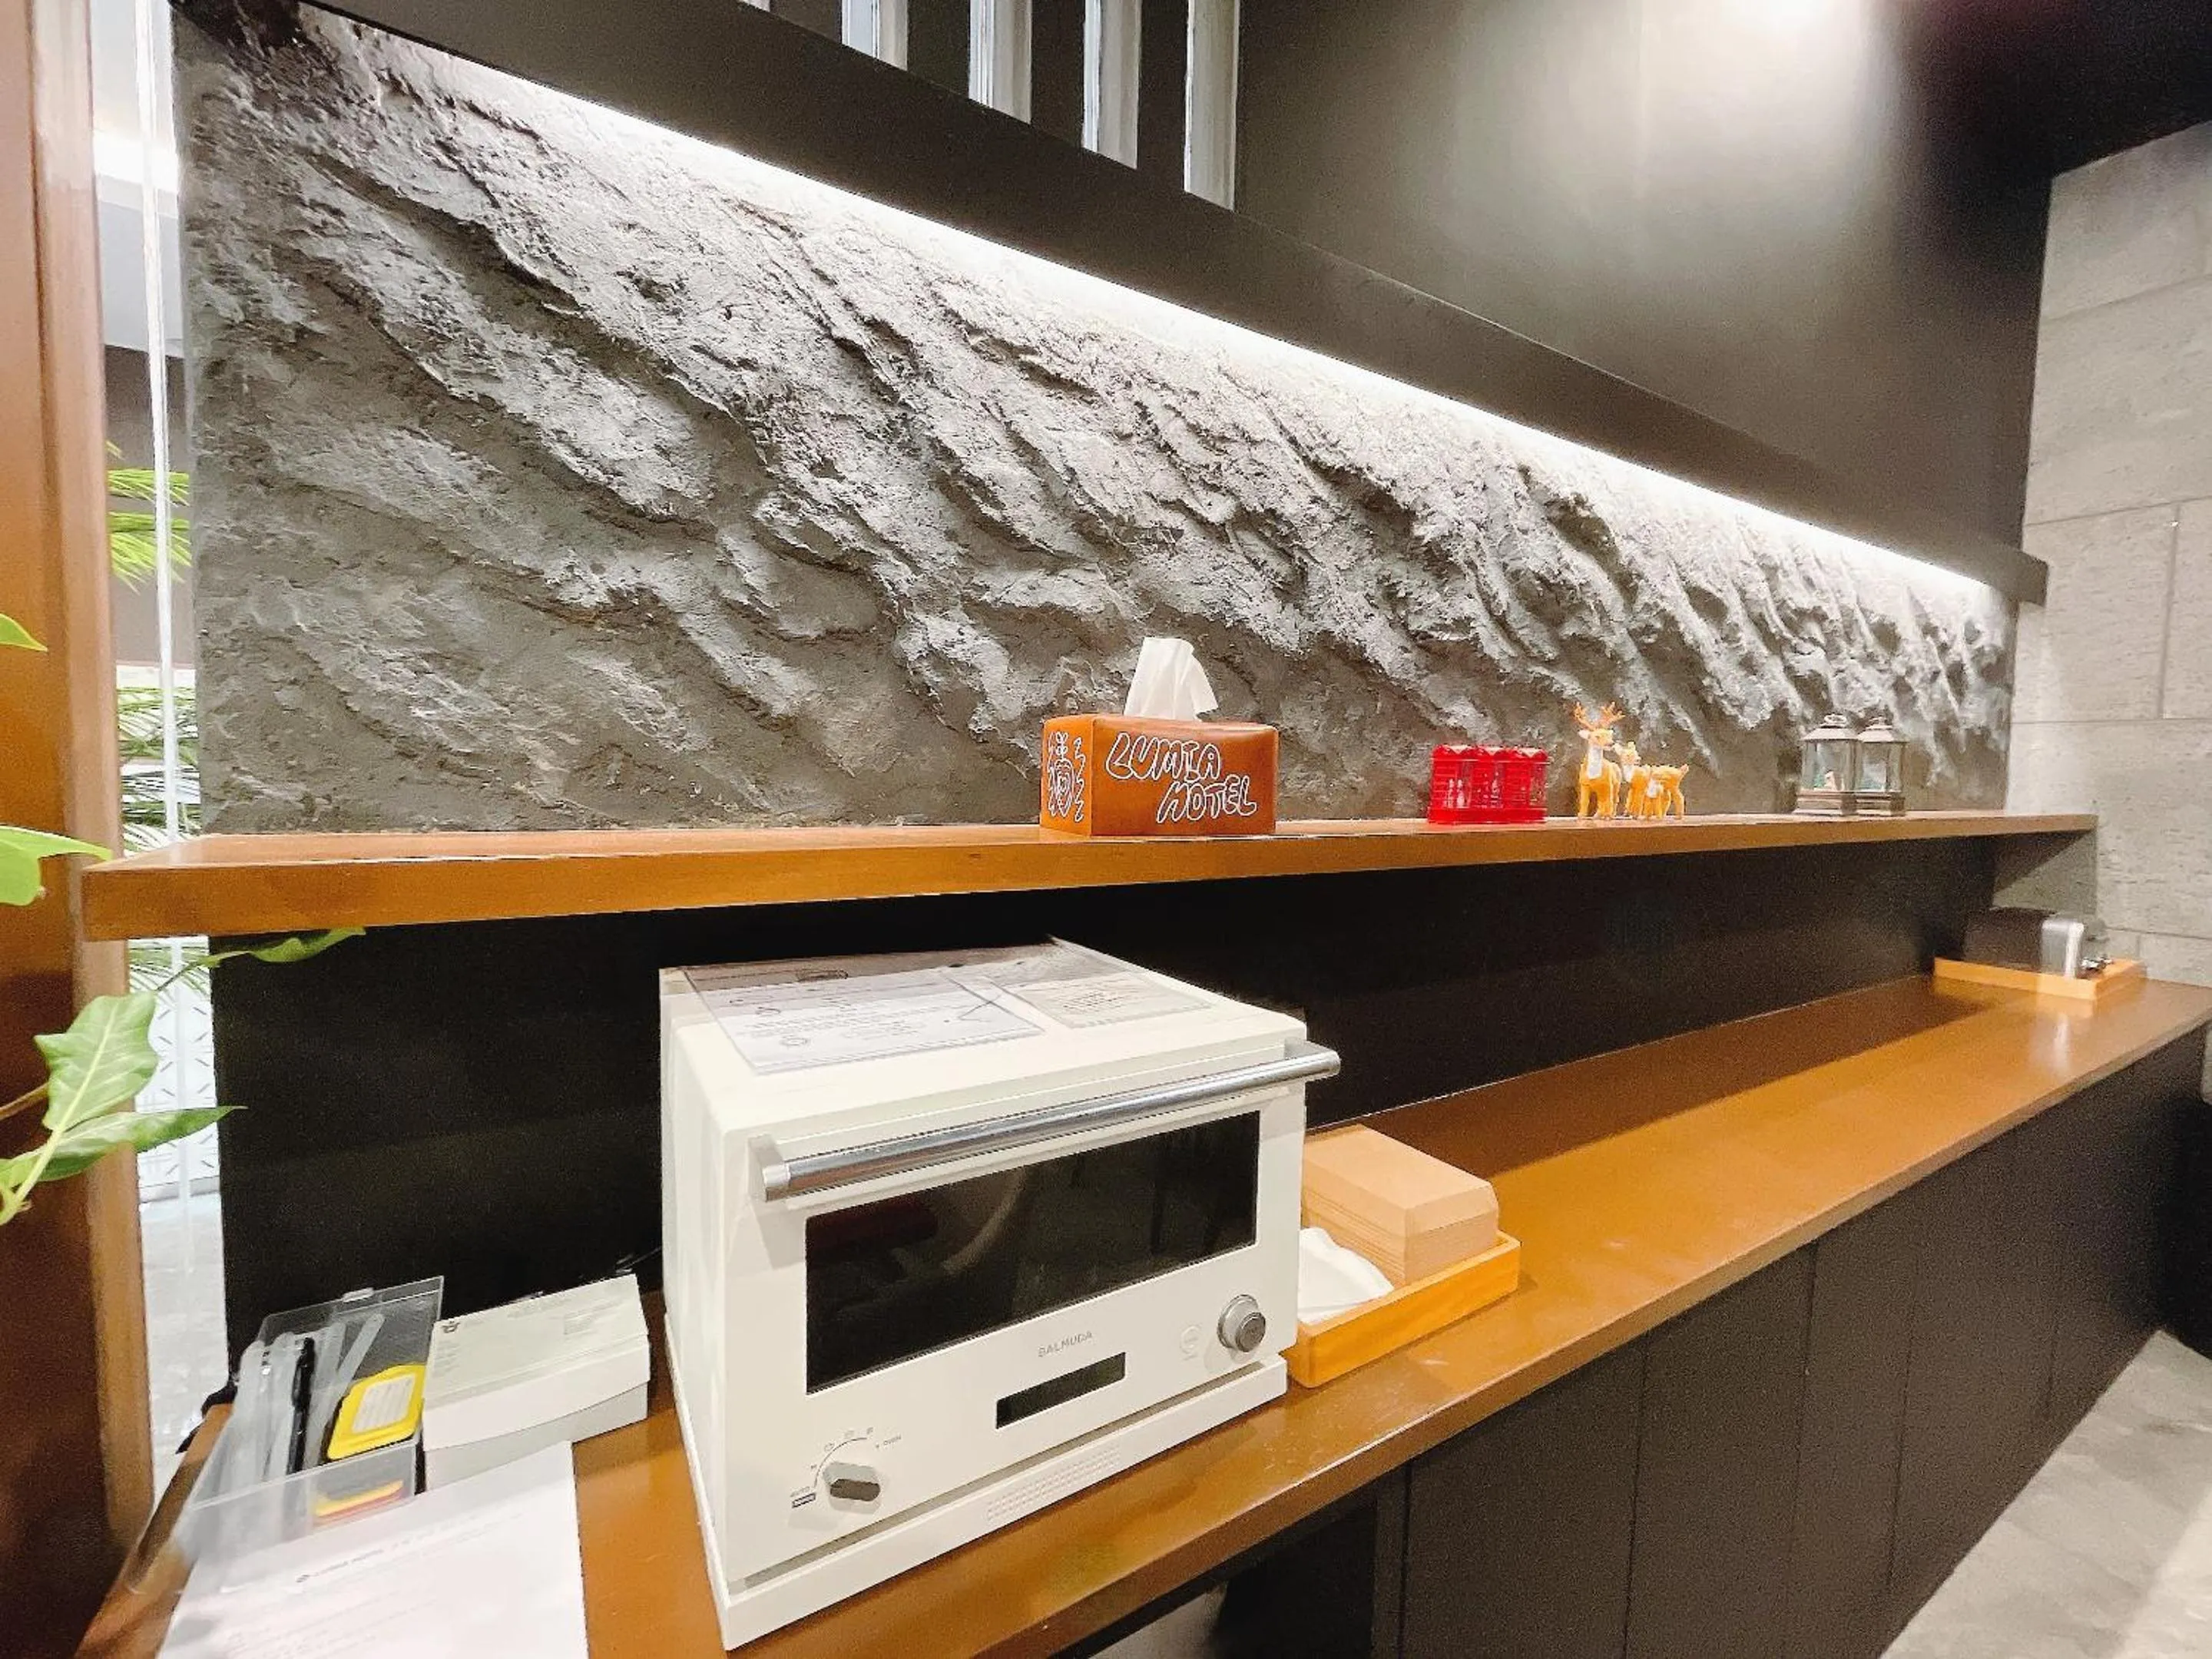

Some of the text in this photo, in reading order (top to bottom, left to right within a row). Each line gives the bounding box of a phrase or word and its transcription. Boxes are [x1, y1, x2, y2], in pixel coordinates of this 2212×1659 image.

[1106, 732, 1220, 782] LUMIA
[1156, 774, 1257, 823] HOTEL
[1038, 1330, 1093, 1358] BALMUDA
